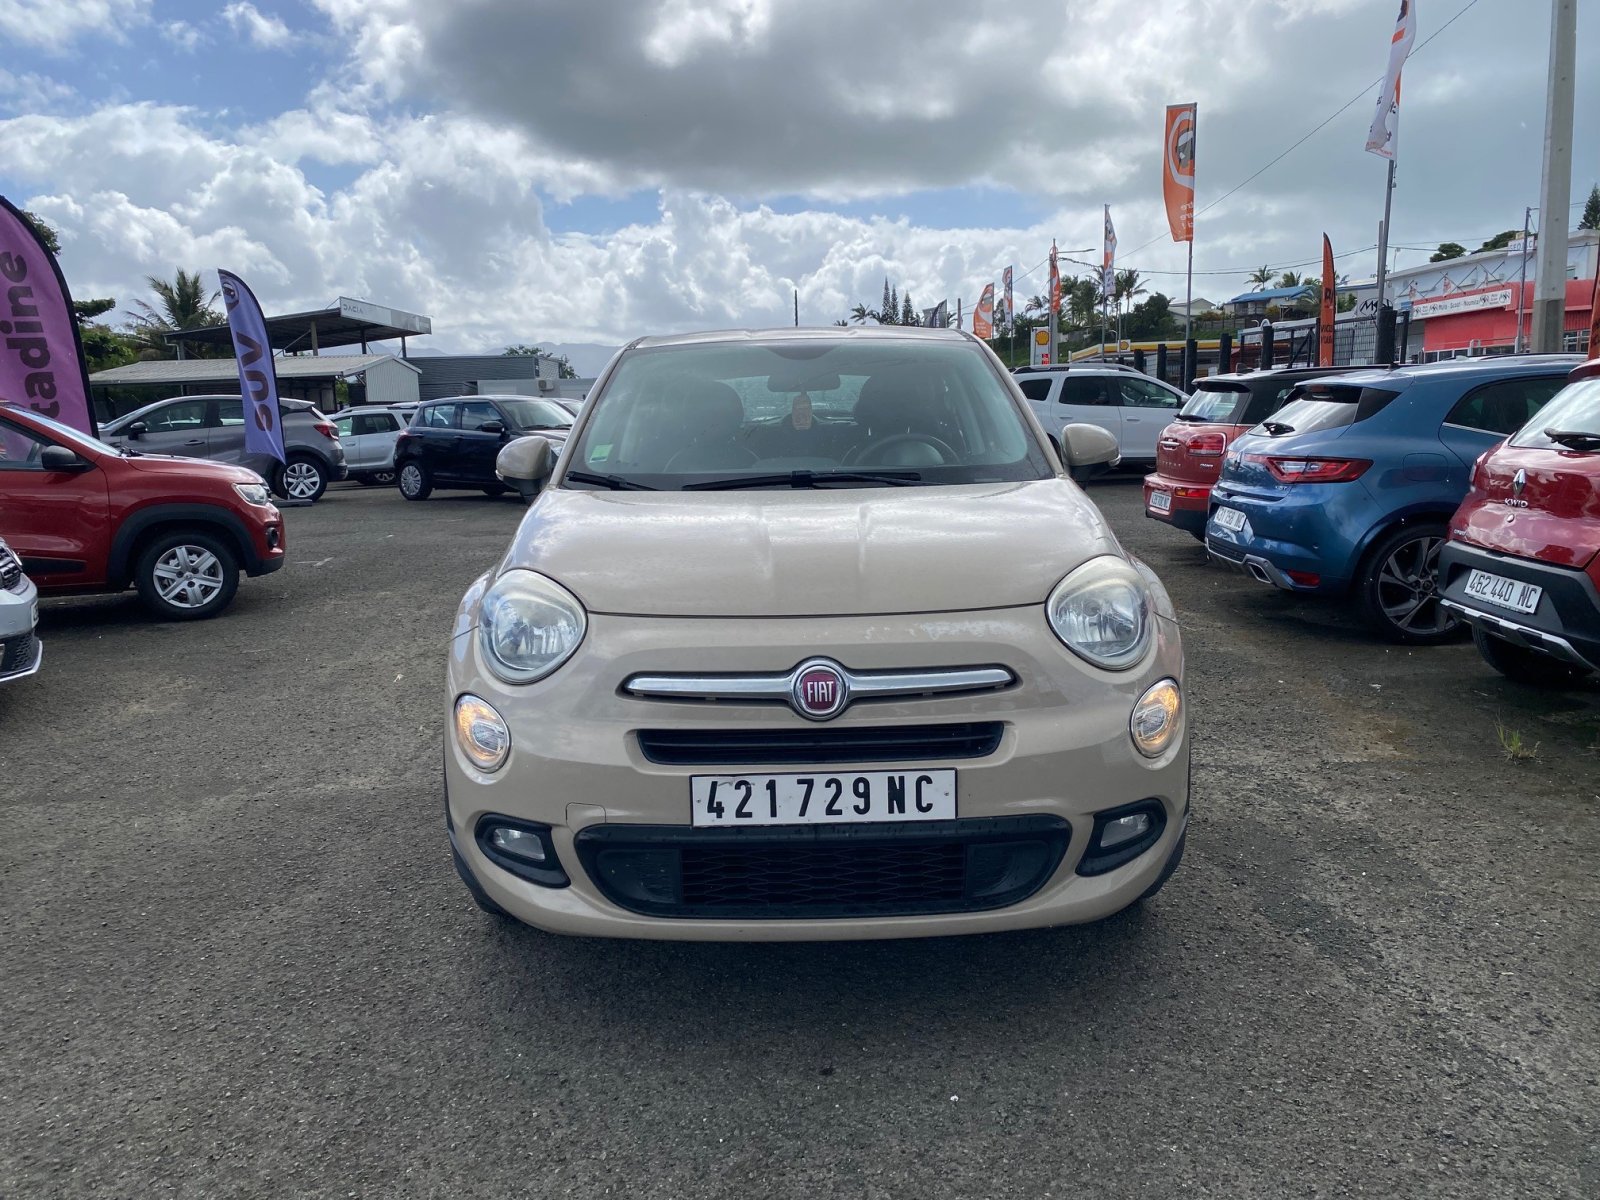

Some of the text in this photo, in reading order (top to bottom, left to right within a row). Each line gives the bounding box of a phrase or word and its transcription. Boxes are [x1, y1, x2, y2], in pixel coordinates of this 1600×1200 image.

[0, 252, 60, 419] tadine
[236, 331, 273, 432] SUV
[1504, 498, 1528, 507] KWID
[1468, 573, 1537, 608] 462 440 NC
[807, 681, 834, 702] FIAT
[707, 775, 933, 819] 421 729 NC
